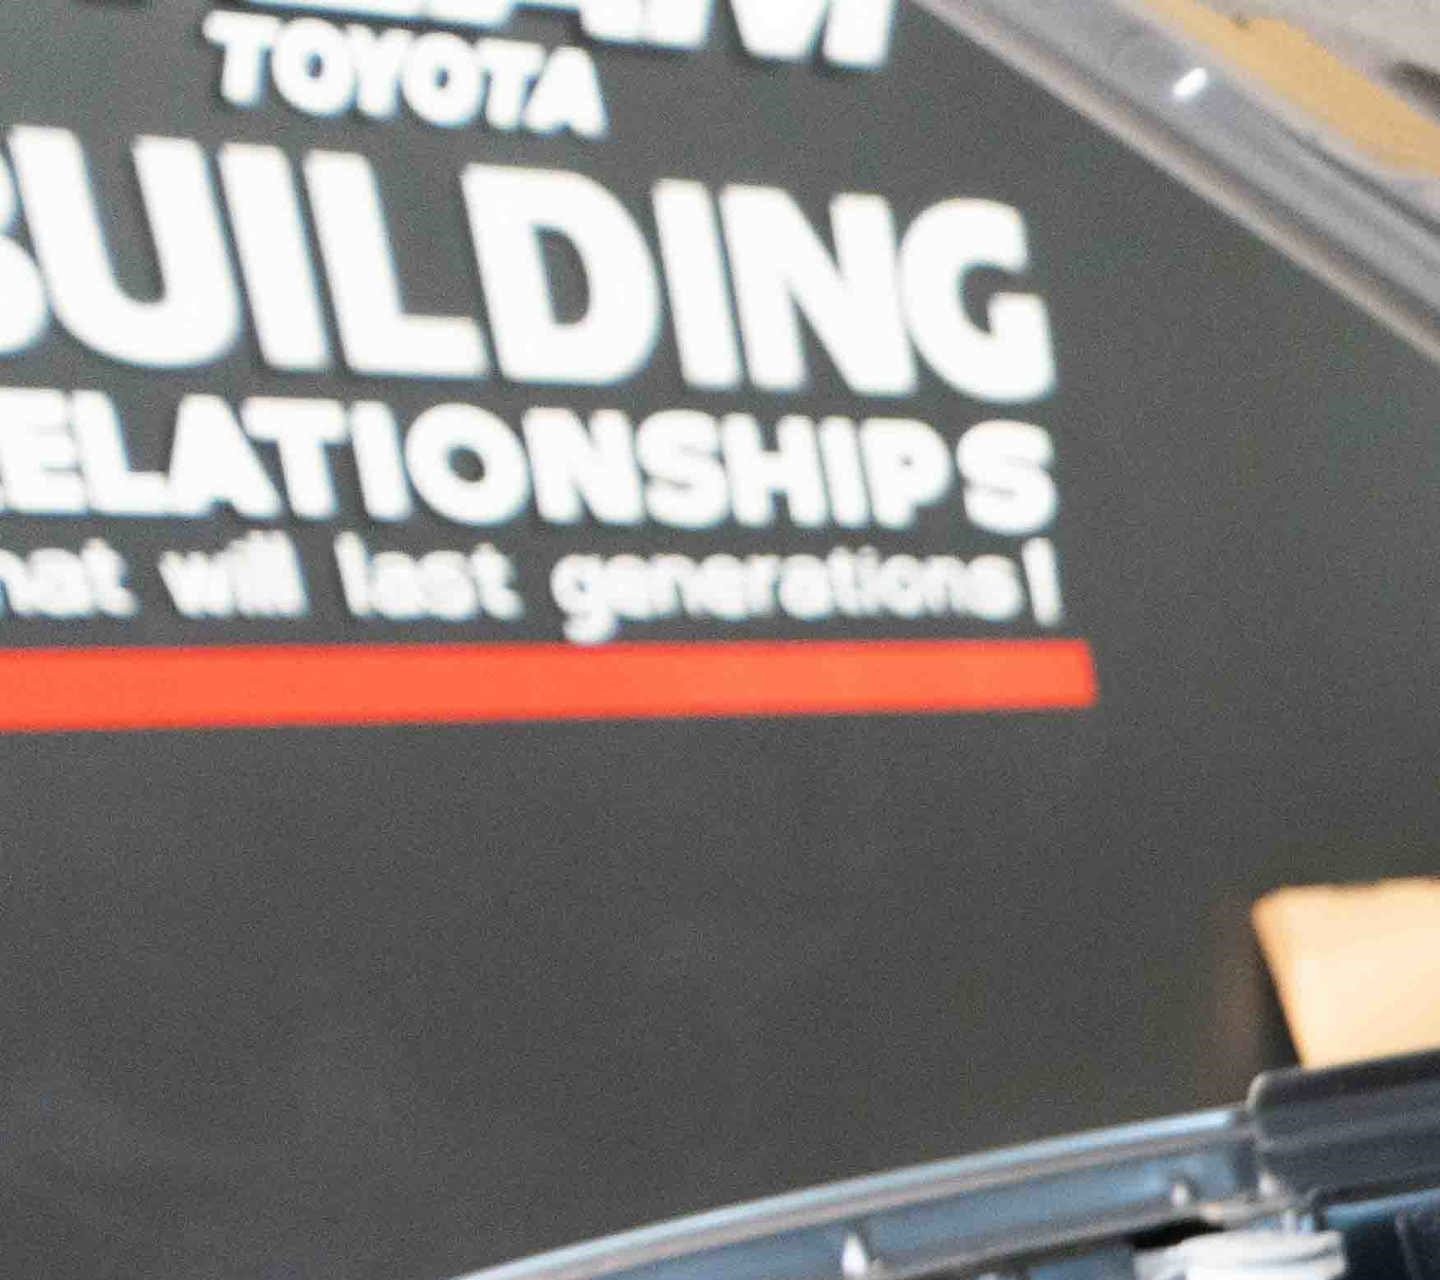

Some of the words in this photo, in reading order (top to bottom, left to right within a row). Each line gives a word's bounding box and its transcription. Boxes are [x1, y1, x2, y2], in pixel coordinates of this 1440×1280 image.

[203, 11, 608, 138] TOYOTA
[0, 387, 1057, 534] ELATIONSHIPS
[158, 530, 309, 618] will
[333, 530, 523, 622] last
[549, 537, 1062, 645] generations!
